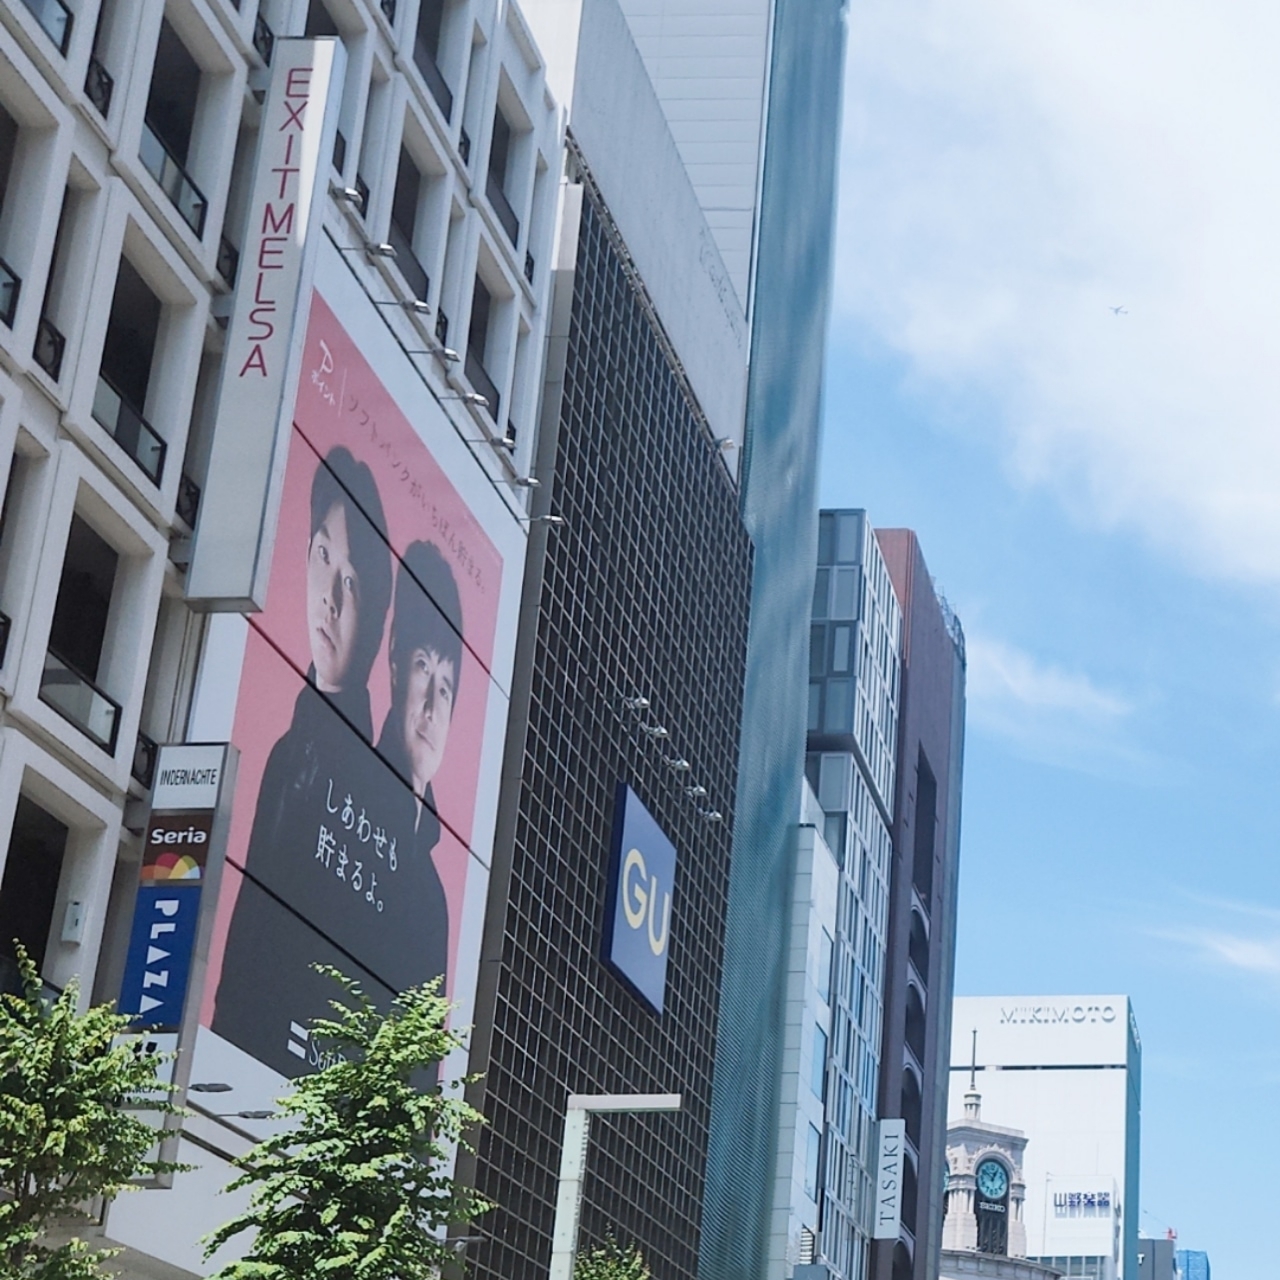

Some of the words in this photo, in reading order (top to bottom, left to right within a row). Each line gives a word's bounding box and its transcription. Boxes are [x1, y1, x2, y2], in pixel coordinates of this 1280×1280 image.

[239, 68, 314, 378] EXITMELSA
[150, 827, 207, 844] Seria
[326, 778, 398, 871] しあわせも
[622, 848, 670, 956] GU
[139, 899, 180, 1014] PLAZA
[1000, 1006, 1117, 1024] MIKIMOTO
[880, 1132, 900, 1227] TASAKI
[979, 1202, 1006, 1213] SEIKO
